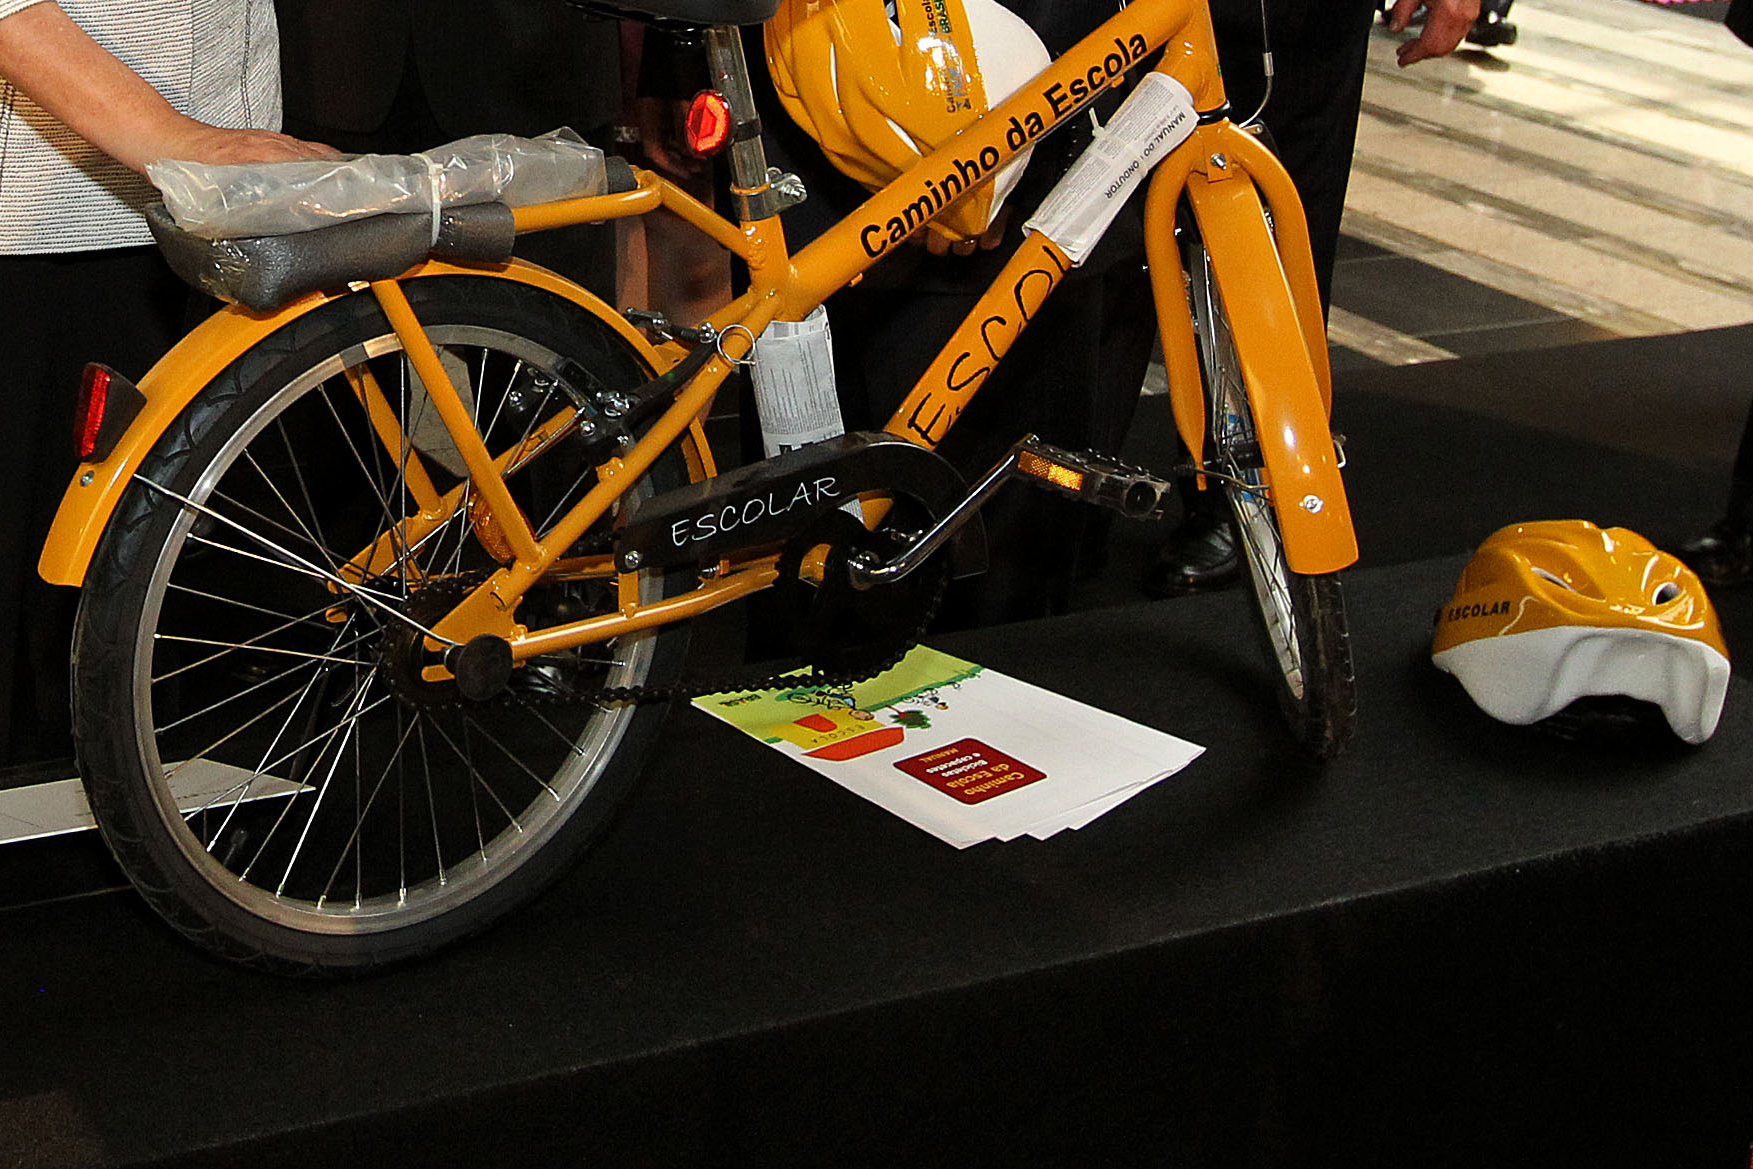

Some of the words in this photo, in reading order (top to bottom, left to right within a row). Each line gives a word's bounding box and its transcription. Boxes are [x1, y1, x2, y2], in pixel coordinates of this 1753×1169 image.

[1154, 111, 1187, 146] MANUAL
[860, 145, 1000, 259] Caminho
[1006, 116, 1045, 152] da
[1043, 33, 1148, 120] Escola
[1143, 142, 1156, 158] DO
[1104, 155, 1145, 200] ONDUTOR
[671, 477, 841, 547] ESCOLAR
[1448, 600, 1511, 622] ESCOLAR
[946, 770, 994, 789] Escola
[990, 763, 1010, 773] da
[963, 771, 1025, 796] Caminho
